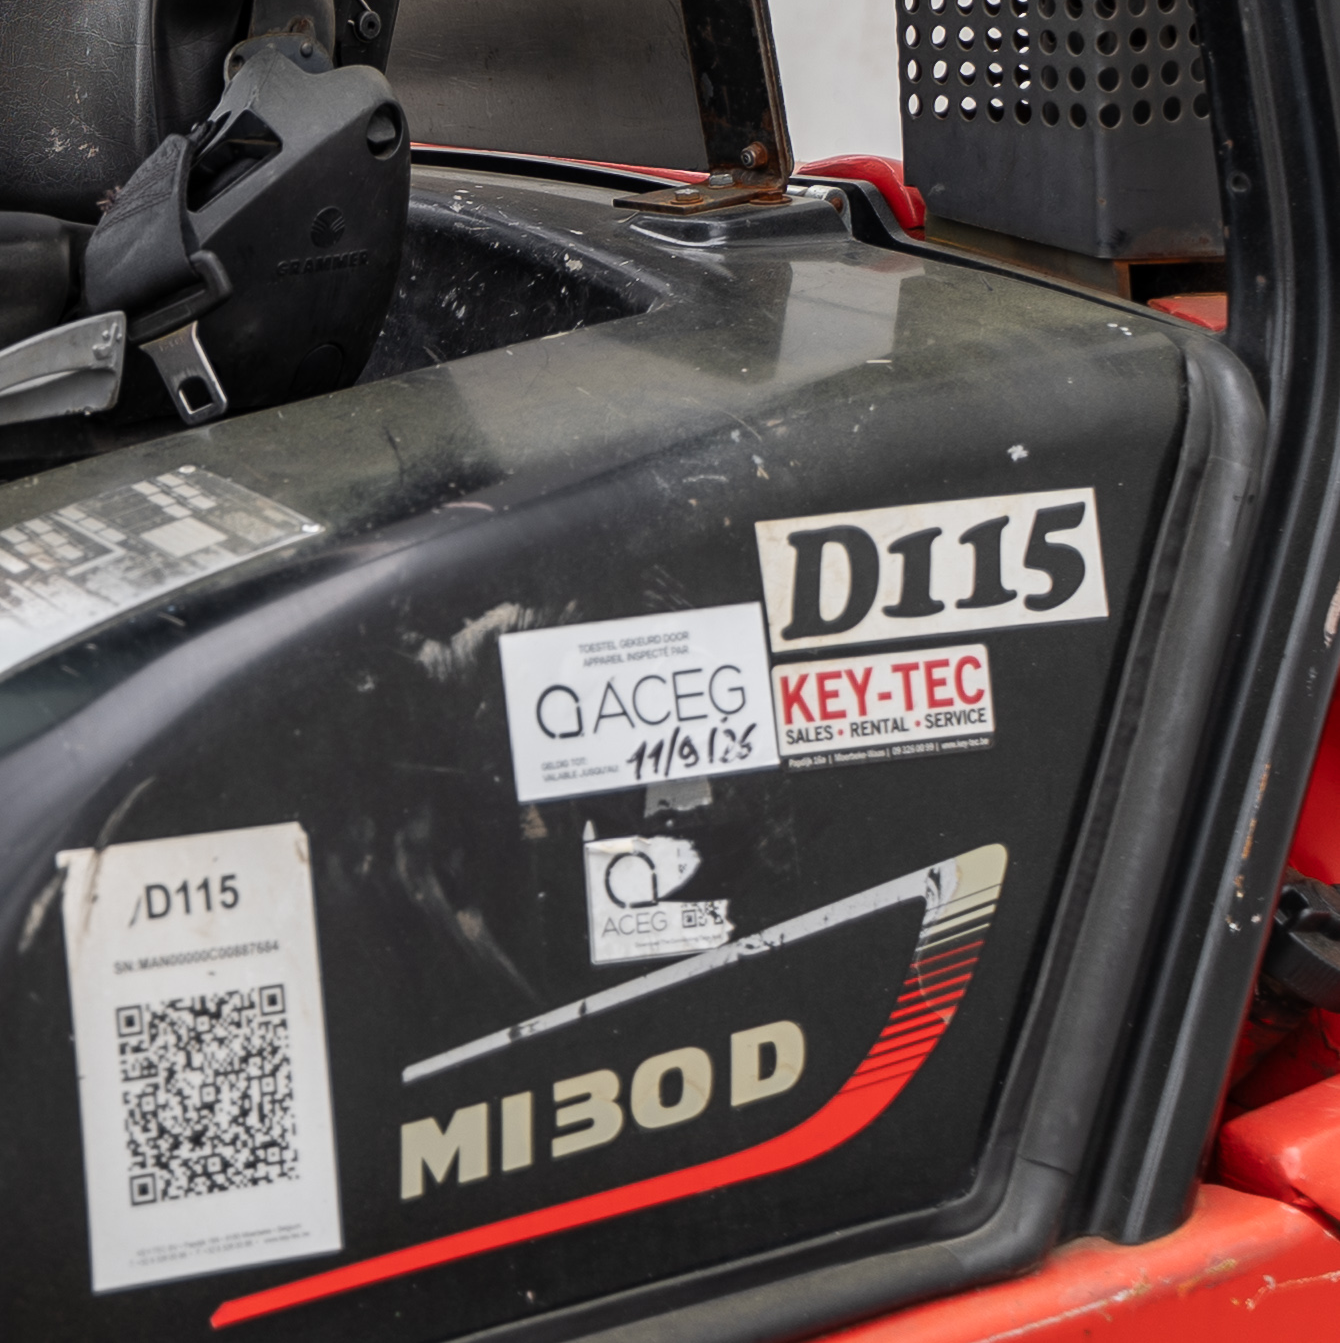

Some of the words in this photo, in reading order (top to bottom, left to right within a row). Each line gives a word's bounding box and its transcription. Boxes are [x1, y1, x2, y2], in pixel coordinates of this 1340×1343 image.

[275, 249, 369, 276] GRAMMER
[781, 501, 1089, 641] D115
[663, 631, 689, 643] DOOR
[593, 664, 746, 734] ACEG
[779, 655, 985, 726] KEY-TEC
[786, 725, 834, 745] SALES
[850, 717, 910, 738] RENTAL
[924, 707, 987, 729] SERVICE
[602, 911, 668, 938] ACEG
